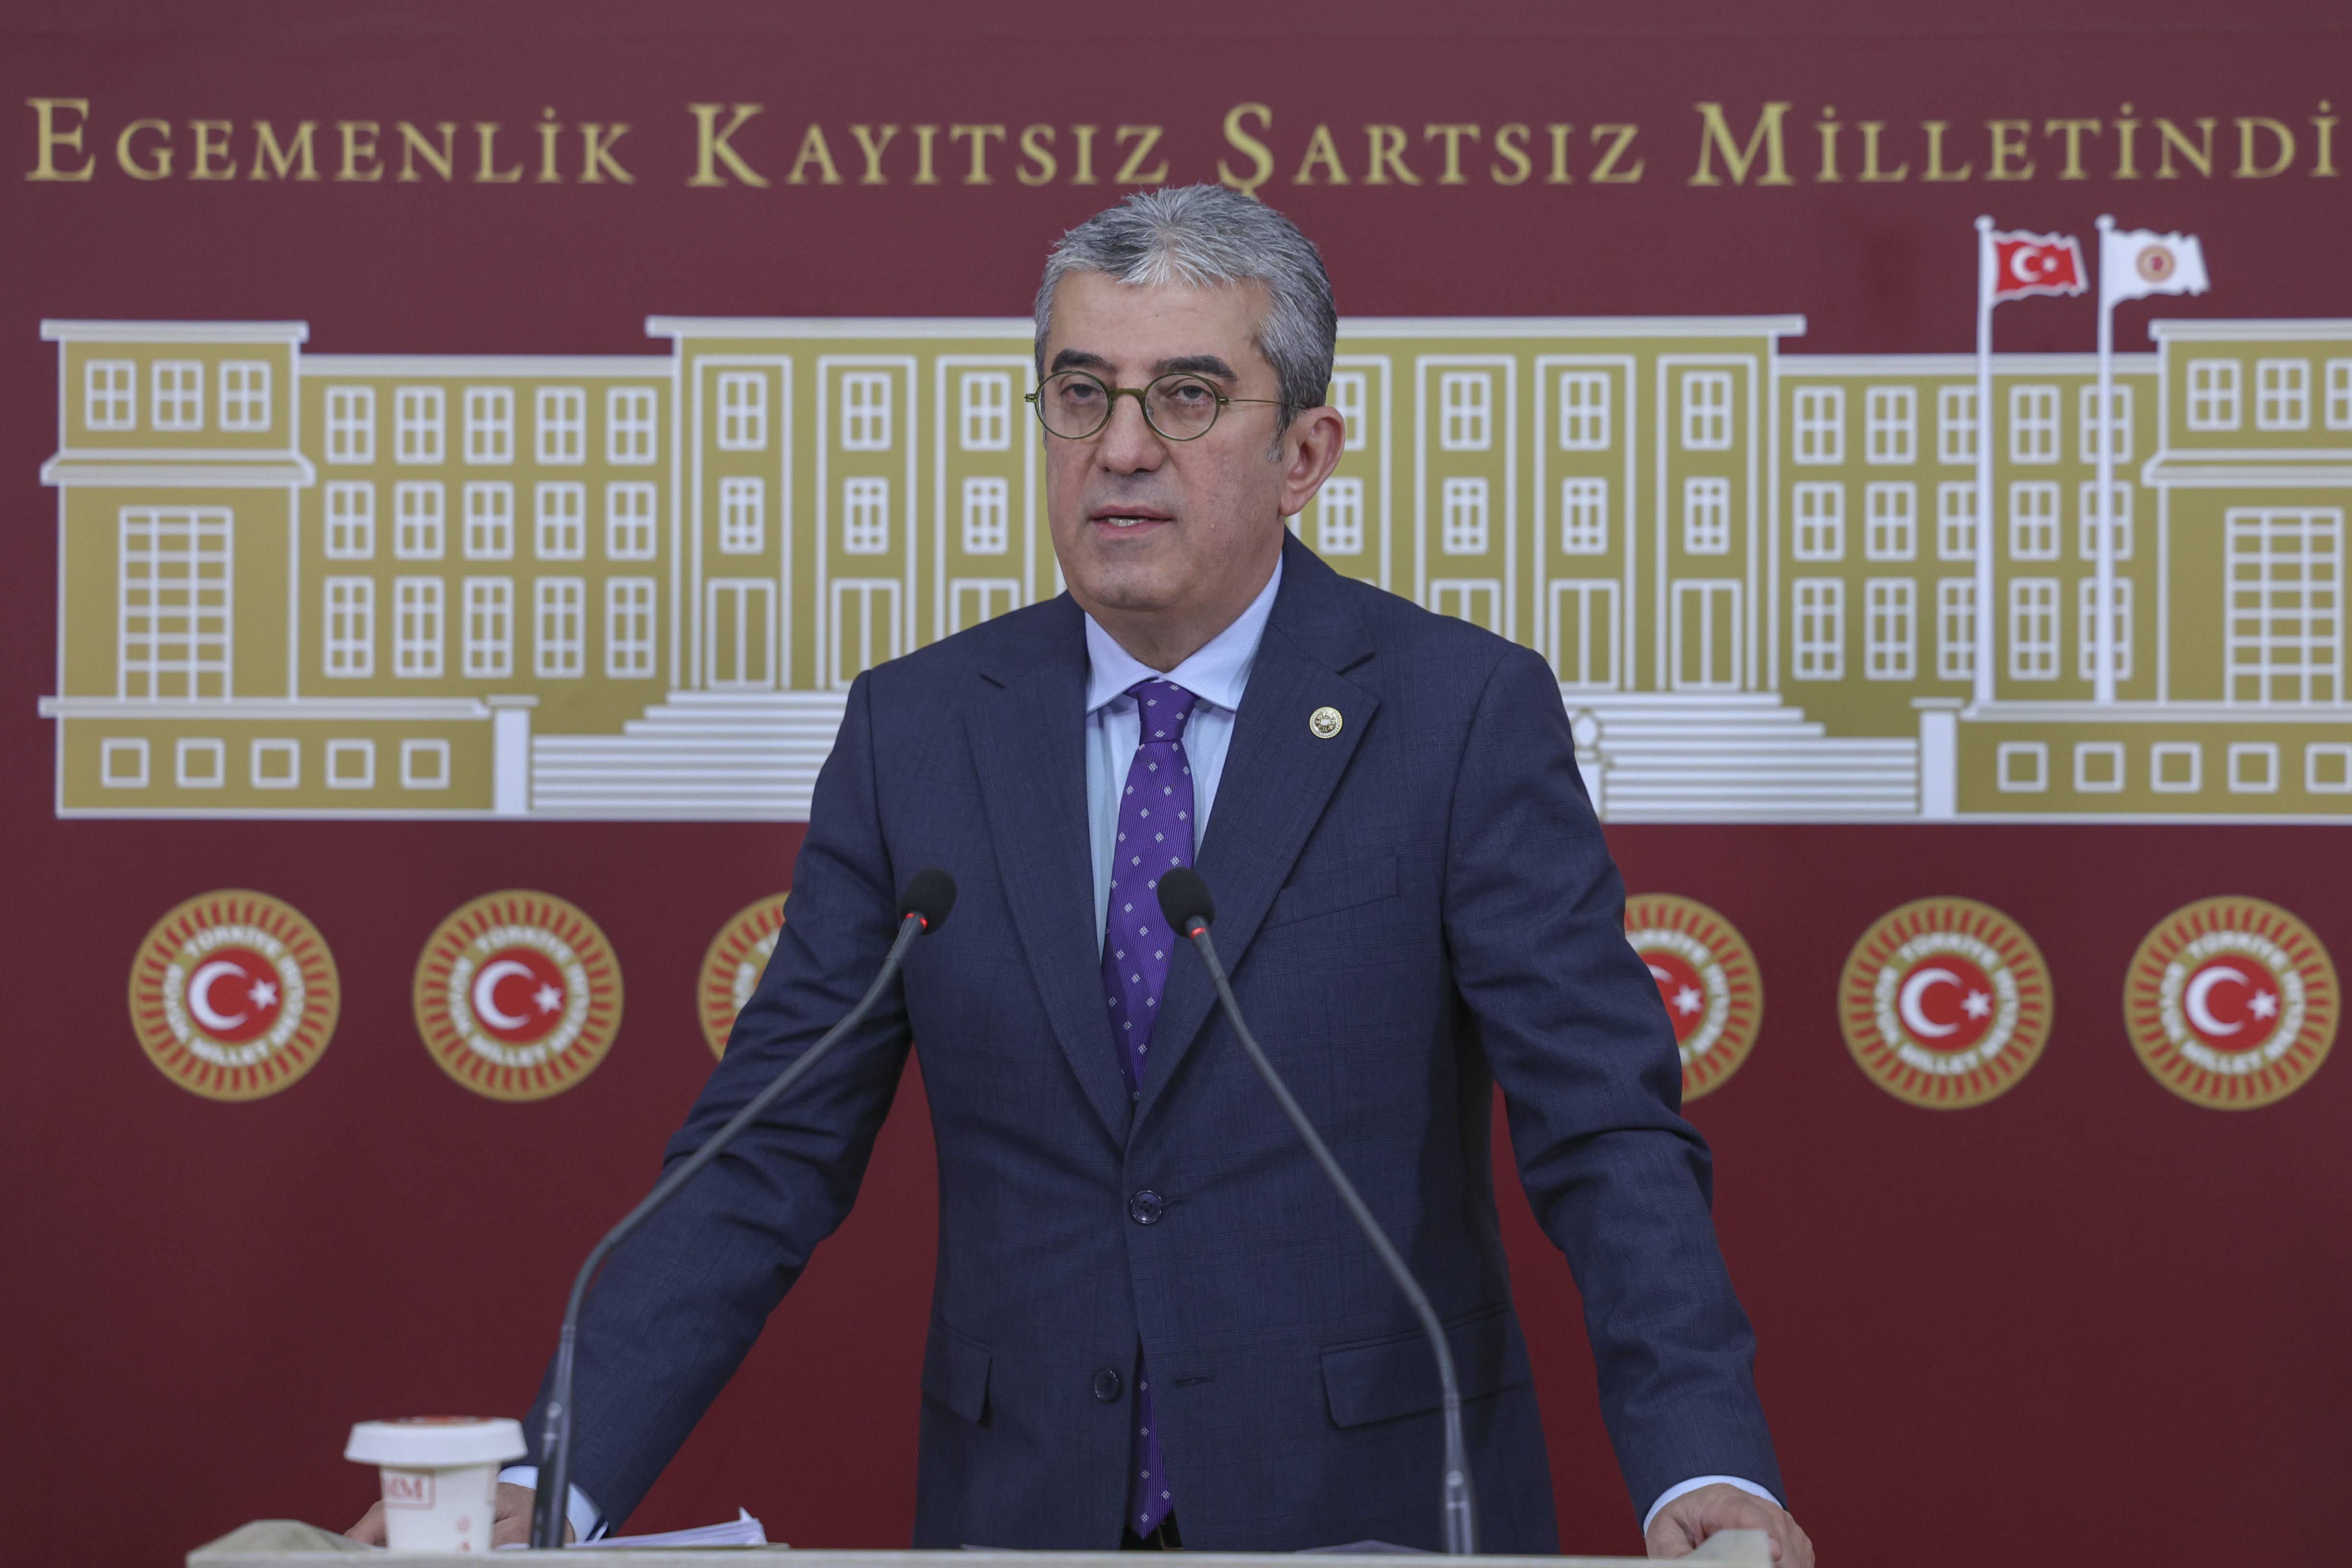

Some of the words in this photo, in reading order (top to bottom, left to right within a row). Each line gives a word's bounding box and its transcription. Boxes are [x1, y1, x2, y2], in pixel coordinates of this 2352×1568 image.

[25, 97, 636, 184] EGEMENLİK
[687, 102, 1170, 188] KAYITSIZ
[1216, 101, 1645, 203] ŞARTSIZ
